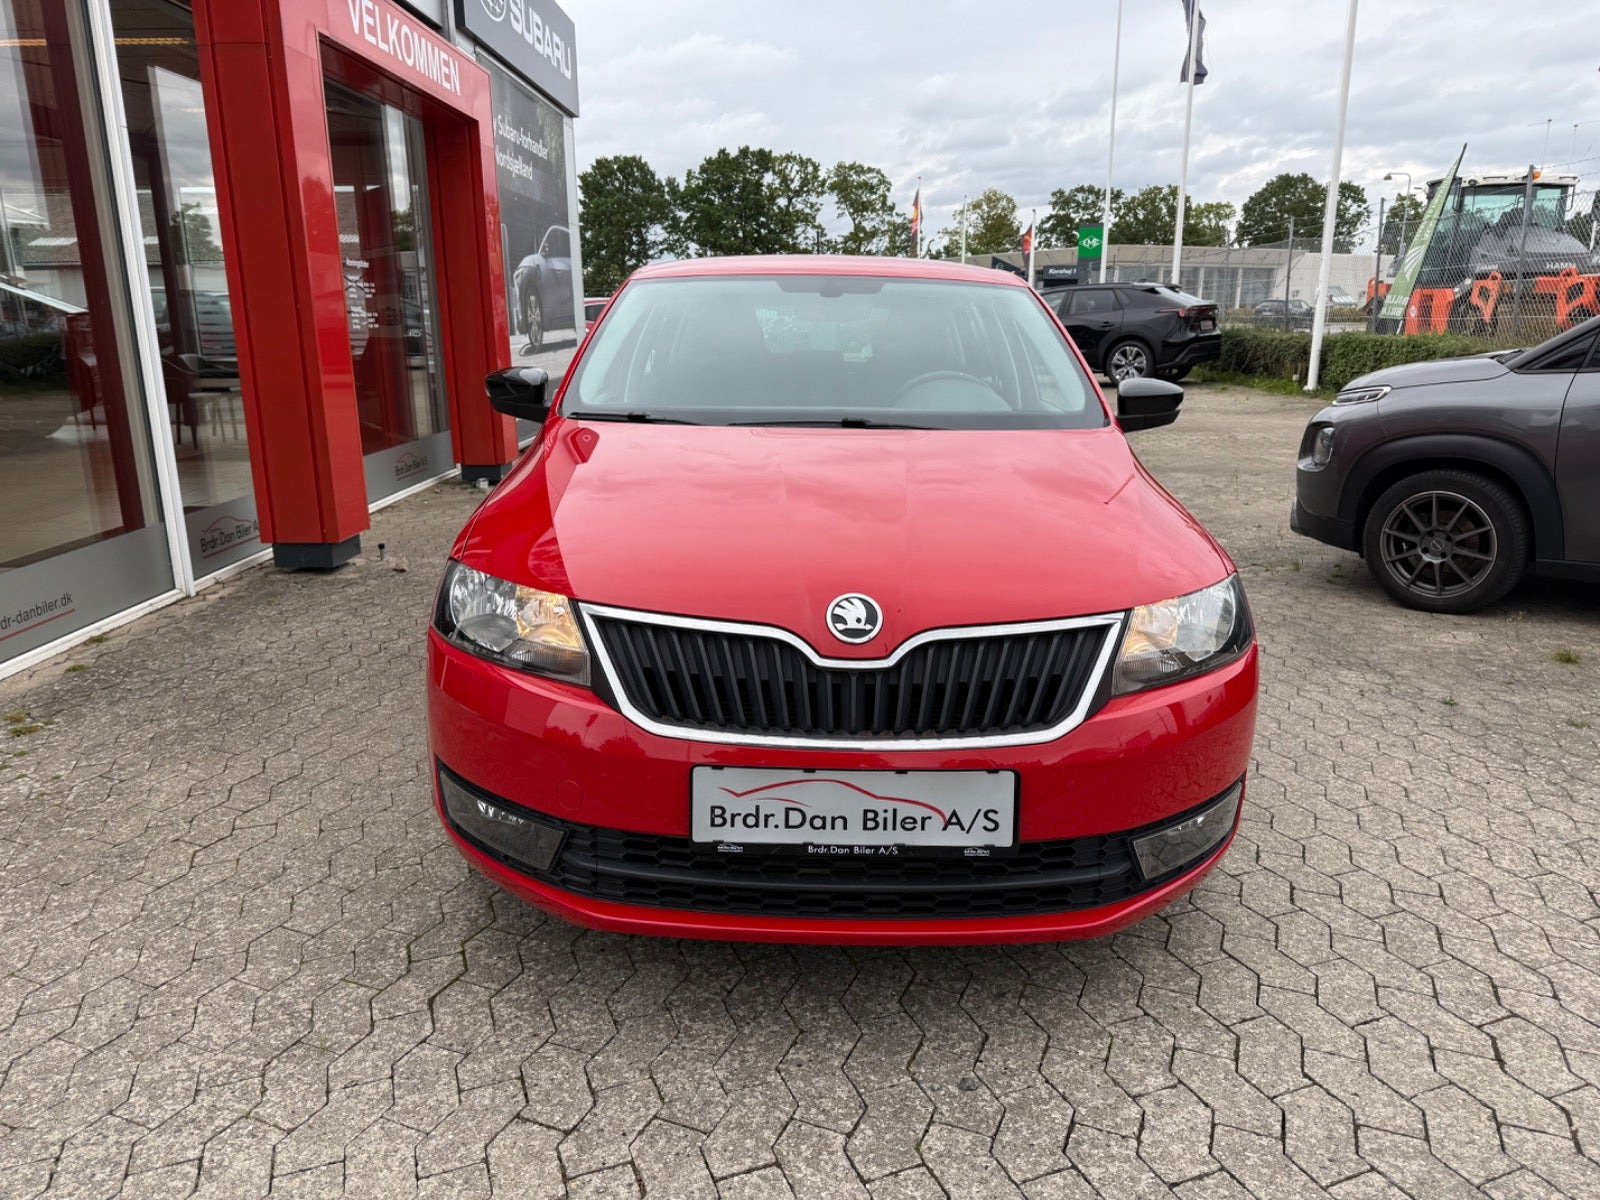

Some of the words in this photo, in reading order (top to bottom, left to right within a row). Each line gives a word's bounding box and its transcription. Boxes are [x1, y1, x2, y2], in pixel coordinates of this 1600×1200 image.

[347, 0, 461, 96] VELKOMMEN
[509, 0, 571, 80] SUBARU
[709, 805, 848, 831] Brdr.Dan
[862, 808, 932, 832] Biler
[942, 808, 1000, 834] A/S
[808, 845, 850, 854] Brdr.Dan
[853, 846, 875, 855] Biler
[878, 846, 898, 856] A/S
